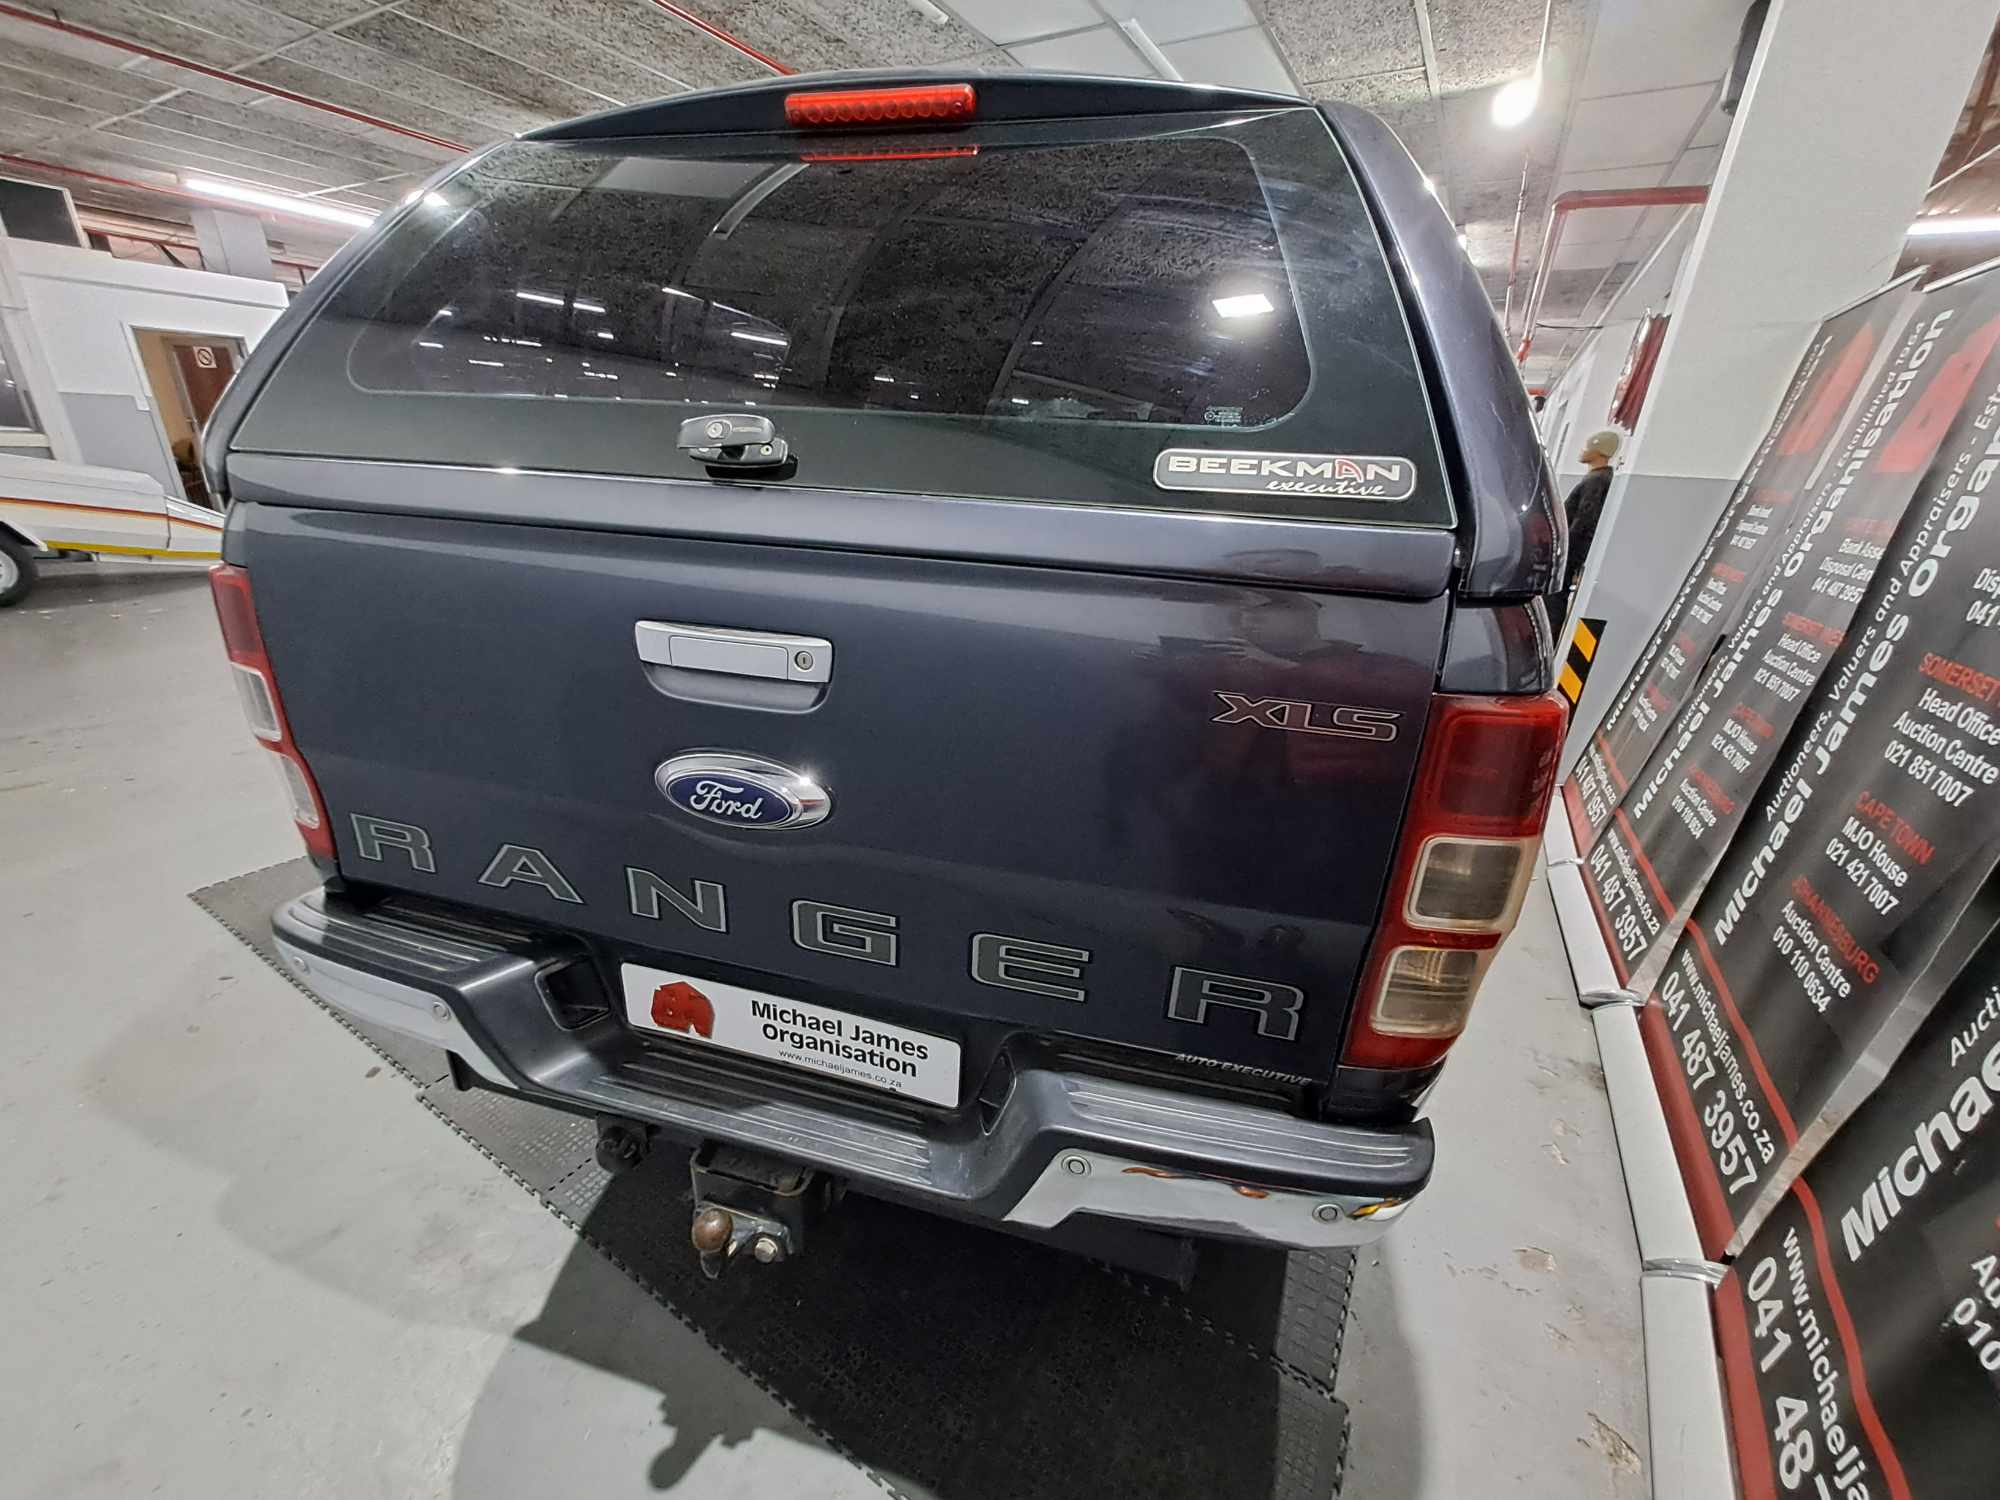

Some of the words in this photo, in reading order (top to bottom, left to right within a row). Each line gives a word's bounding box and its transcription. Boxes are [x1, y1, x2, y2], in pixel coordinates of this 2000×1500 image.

[1167, 455, 1400, 482] BEEKMAN
[1265, 480, 1386, 496] executive
[1634, 701, 1710, 819] Michael
[1713, 588, 1783, 698] James
[1784, 309, 1954, 577] Organisation
[1728, 599, 1762, 649] Valuers
[1762, 565, 1781, 595] and
[1766, 710, 1832, 821] Auctioneers,
[1829, 626, 1876, 700] Valuers
[1876, 578, 1902, 622] and
[1901, 452, 1971, 576] Appraisers
[1211, 689, 1401, 742] XLS
[1893, 711, 1947, 754] Auction
[1945, 739, 1999, 784] Centre
[1918, 687, 1963, 722] Head
[1957, 706, 2000, 745] Office
[689, 780, 763, 819] Ford
[1714, 778, 1814, 946] Michael
[1815, 614, 1909, 775] James
[1884, 740, 1911, 768] 021
[1908, 755, 1937, 785] 851
[1930, 770, 1975, 807] 7007
[1856, 791, 1895, 830] CAPE
[1825, 838, 1850, 867] 021
[1847, 858, 1870, 887] 421
[1864, 877, 1900, 915] 7007
[1842, 816, 1874, 850] MJO
[1869, 840, 1908, 887] House
[350, 813, 1304, 1040] RANGER
[1591, 844, 1612, 881] 041
[1603, 874, 1626, 911] 487
[1615, 904, 1648, 960] 3957
[1773, 926, 1793, 955] 010
[1790, 950, 1809, 978] 110
[1803, 971, 1832, 1013] 0634
[1782, 900, 1819, 953] Auction
[1815, 945, 1851, 998] Centre
[751, 1000, 843, 1037] Michael
[849, 1020, 930, 1060] James
[762, 1023, 917, 1077] Organisation
[1682, 949, 1774, 1164] www.michaeljames.co.za
[778, 1049, 902, 1088] www.michaeljames.co.za
[1176, 1053, 1220, 1068] AUTO
[1220, 1062, 1313, 1086] EXECUTIVE
[1663, 972, 1690, 1031] 041
[1682, 1029, 1716, 1090] 487
[1704, 1090, 1757, 1194] 3957
[1748, 1257, 1792, 1373] 041
